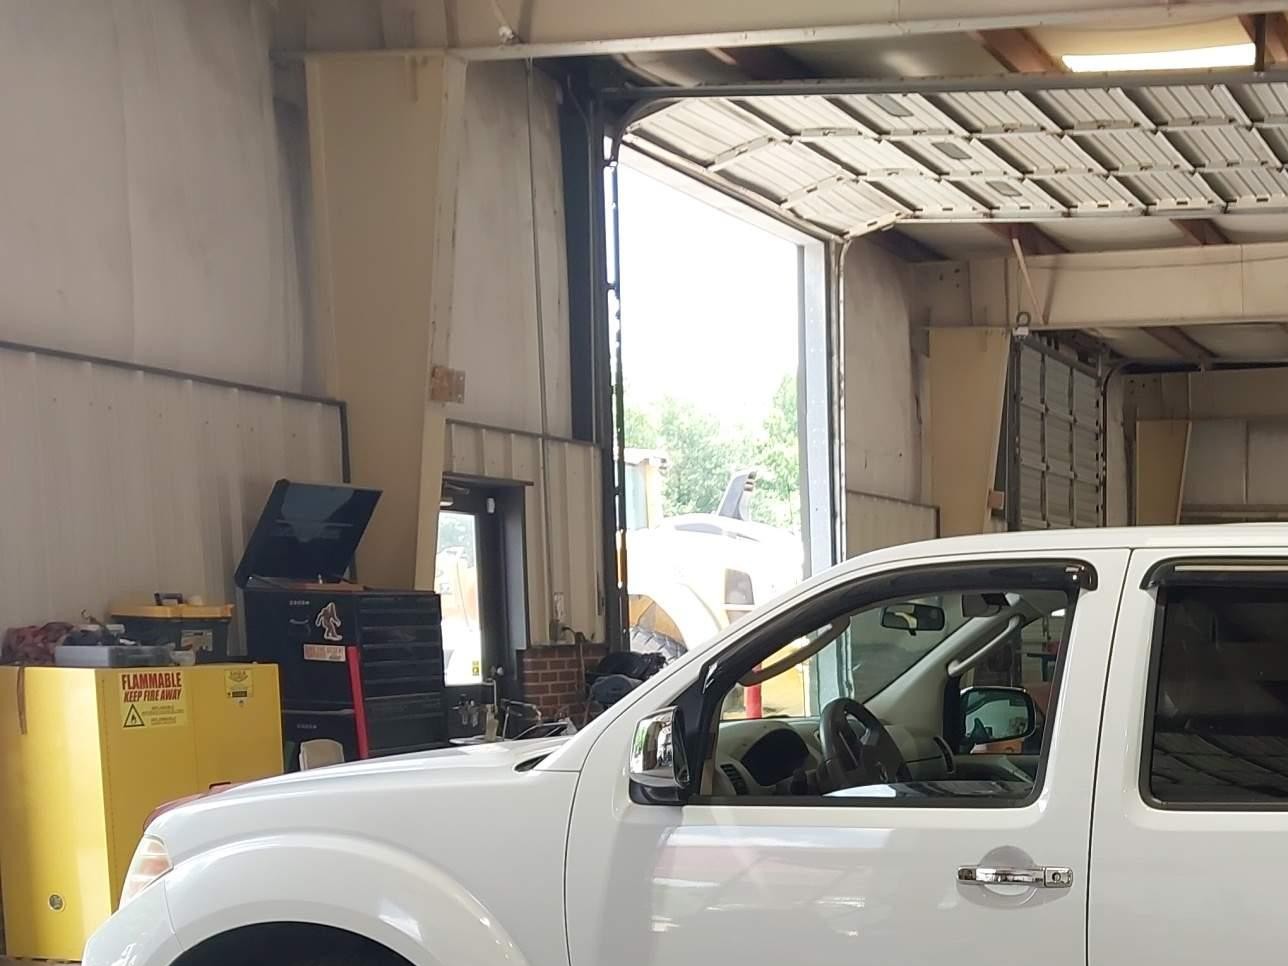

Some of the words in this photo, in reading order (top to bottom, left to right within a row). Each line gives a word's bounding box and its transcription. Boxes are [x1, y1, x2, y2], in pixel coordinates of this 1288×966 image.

[121, 671, 182, 690] FLAMMABLE
[123, 690, 143, 703] KEEP
[143, 690, 159, 702] FIRE
[160, 688, 182, 701] AWAY
